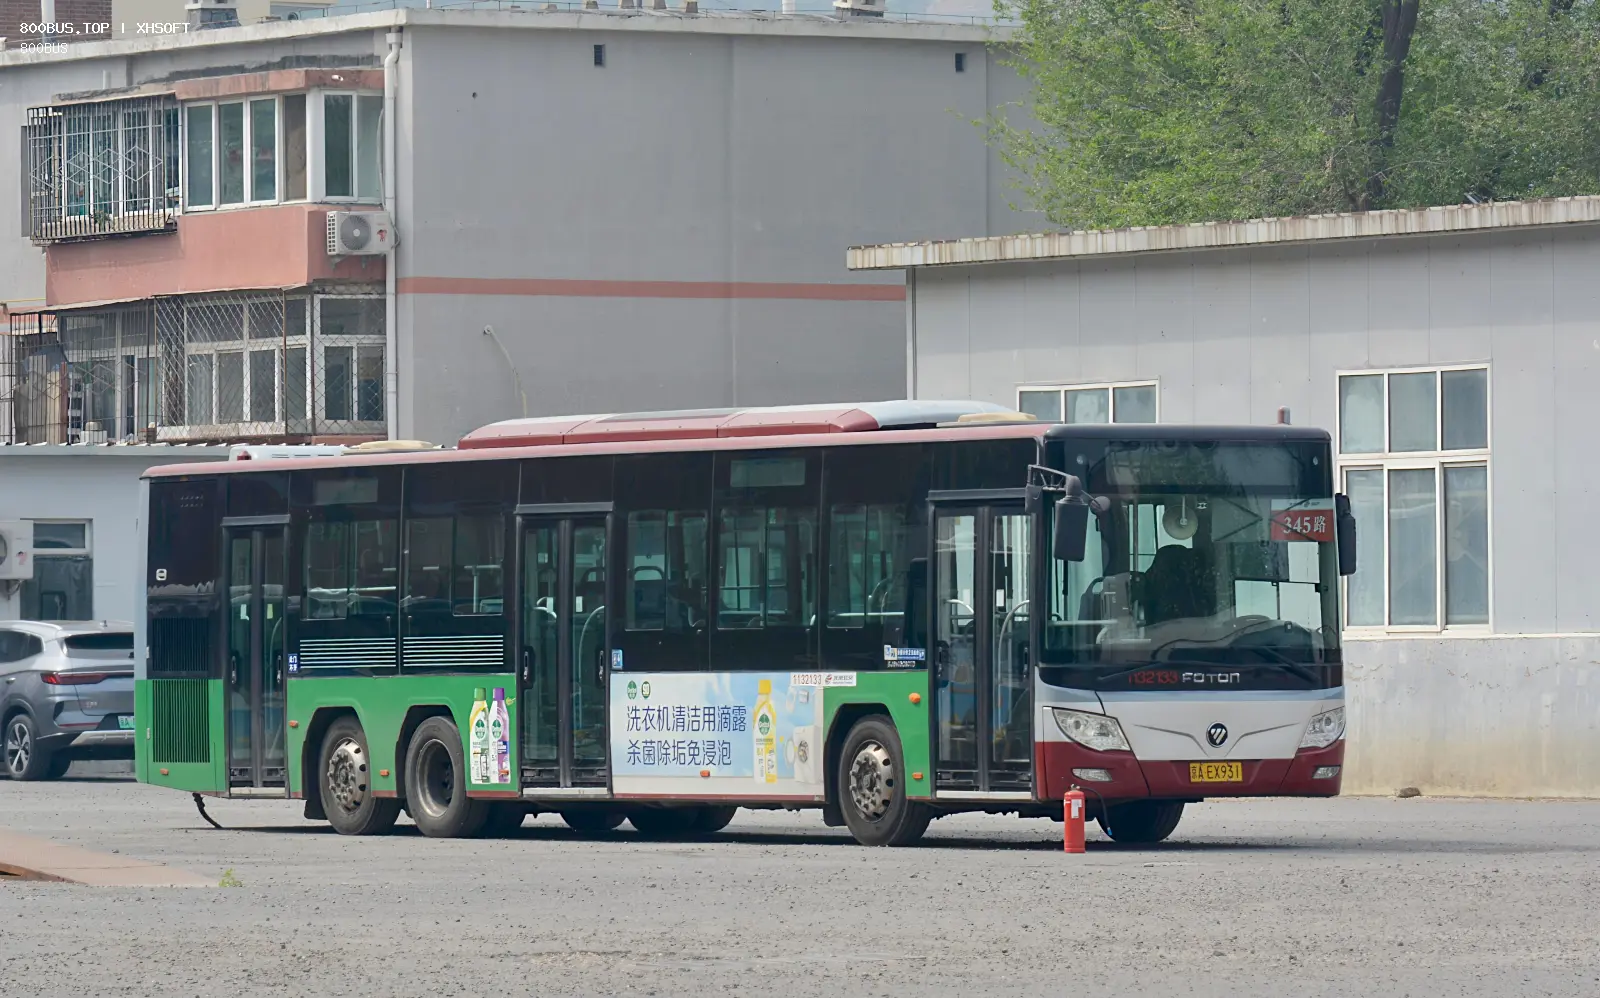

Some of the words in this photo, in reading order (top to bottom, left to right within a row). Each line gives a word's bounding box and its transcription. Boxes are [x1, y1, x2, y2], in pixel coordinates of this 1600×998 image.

[1283, 515, 1326, 534] 345路
[793, 674, 822, 685] 1132133
[1182, 672, 1240, 684] FOTON
[626, 705, 747, 732] 洗衣机清洁用滴露
[626, 739, 732, 766] 杀菌除垢免浸泡
